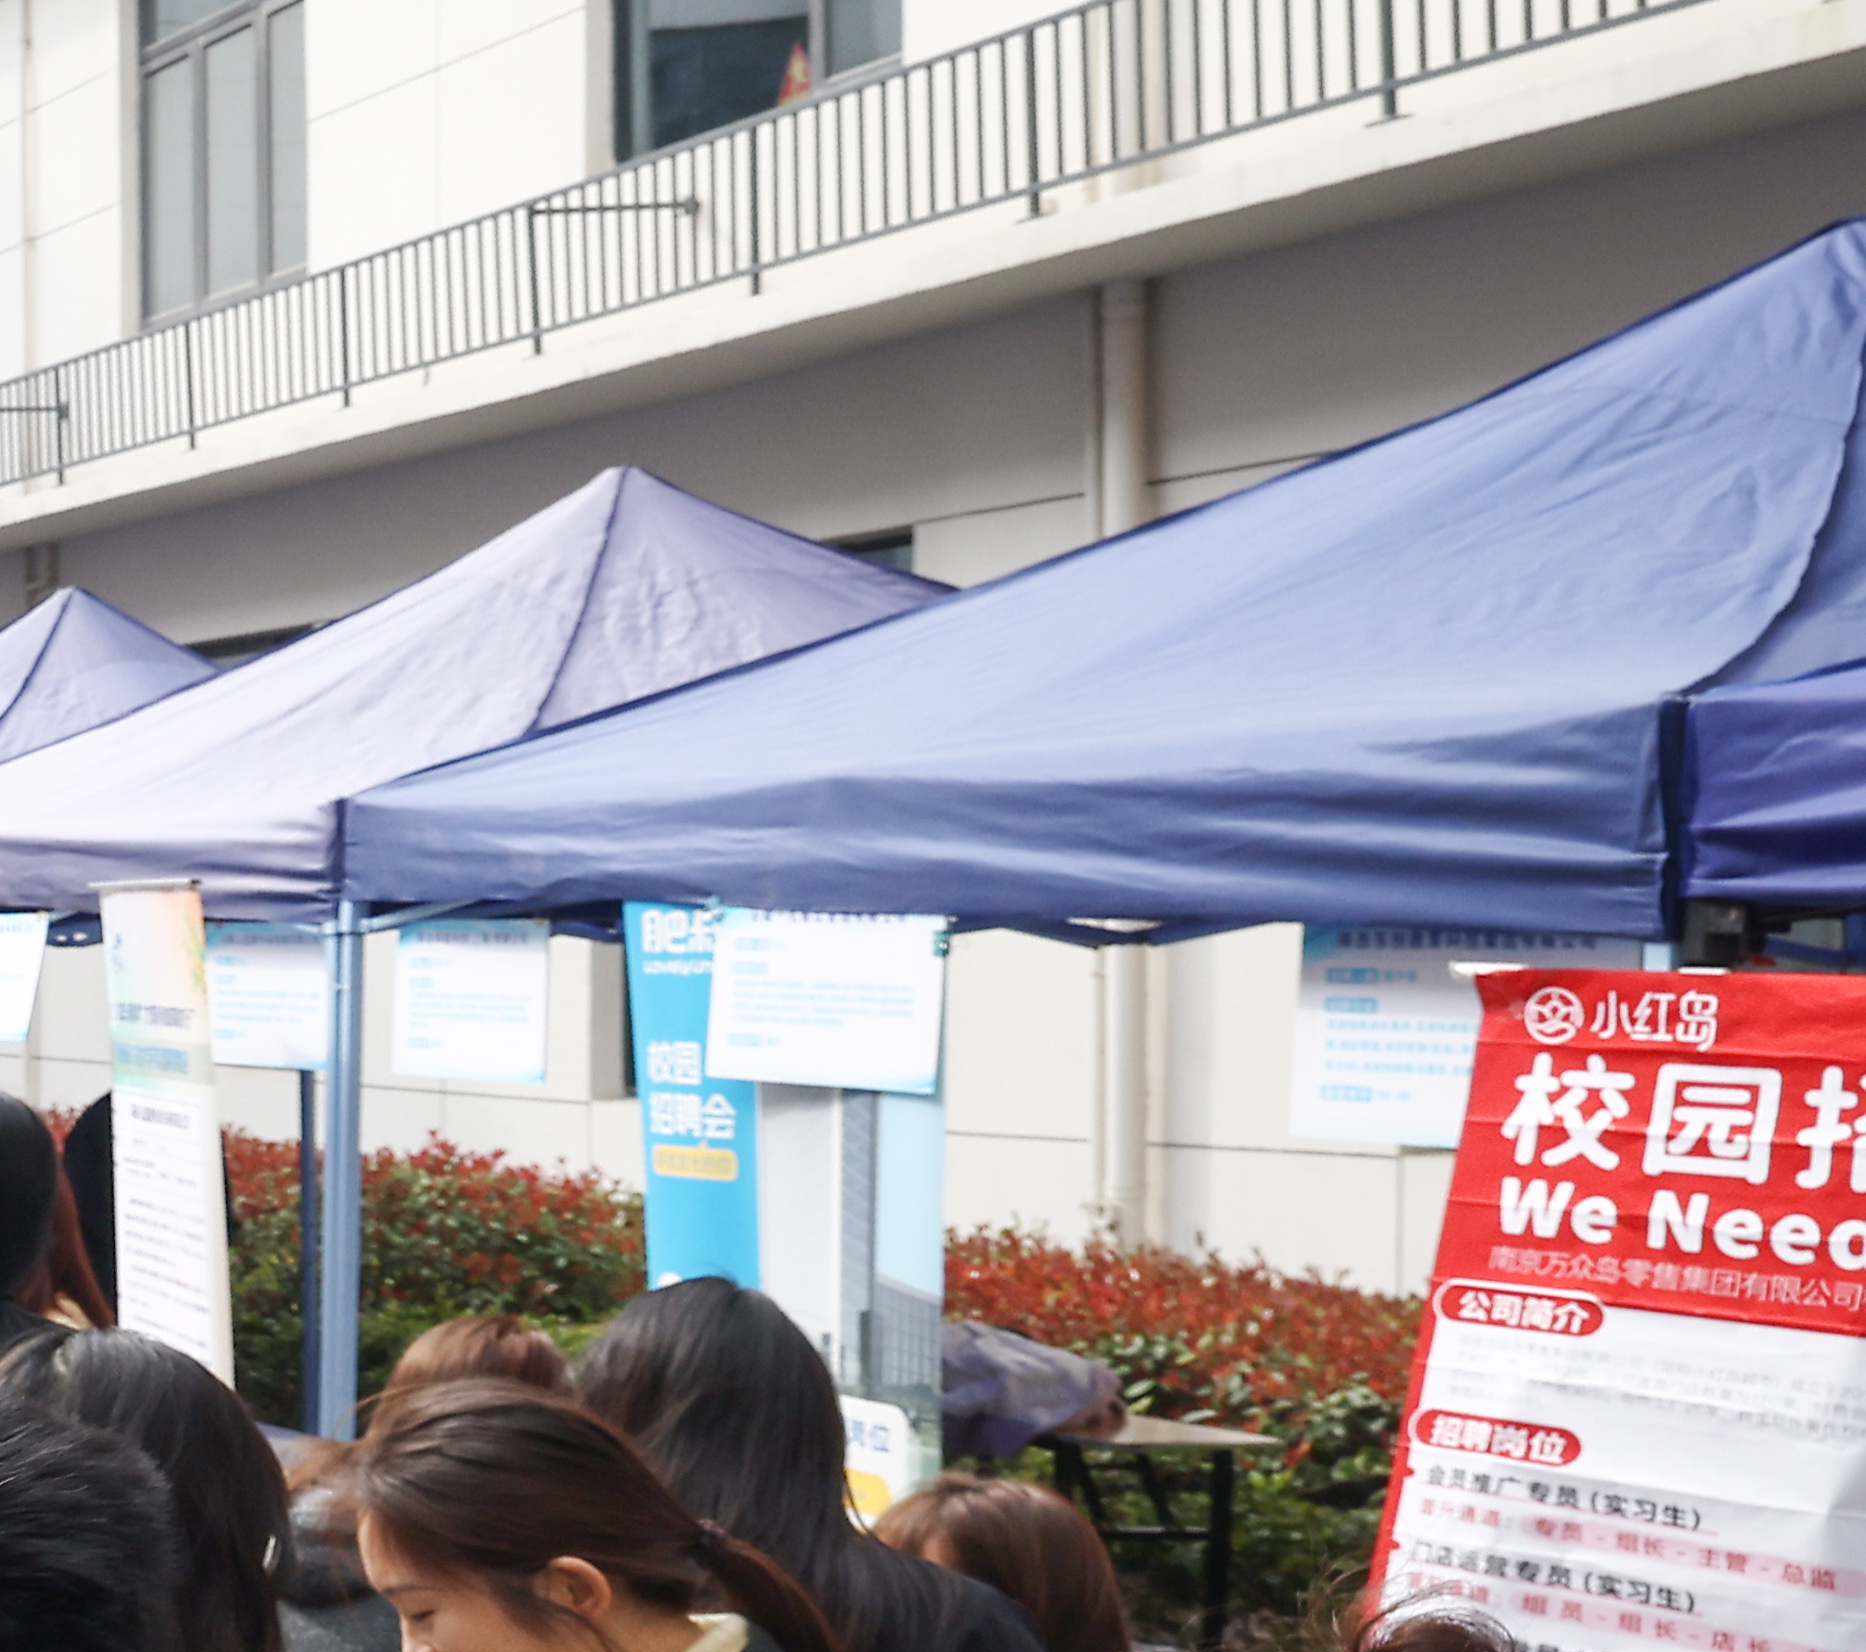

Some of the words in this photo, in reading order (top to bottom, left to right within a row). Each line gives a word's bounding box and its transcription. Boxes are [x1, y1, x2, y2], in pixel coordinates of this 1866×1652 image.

[1590, 990, 1718, 1051] 小红岛
[1500, 1176, 1618, 1245] We
[1489, 1246, 1866, 1312] 南京万众岛零售集团有限公司
[1458, 1290, 1588, 1334] 公司简介
[1430, 1414, 1566, 1464] 招聘岗位
